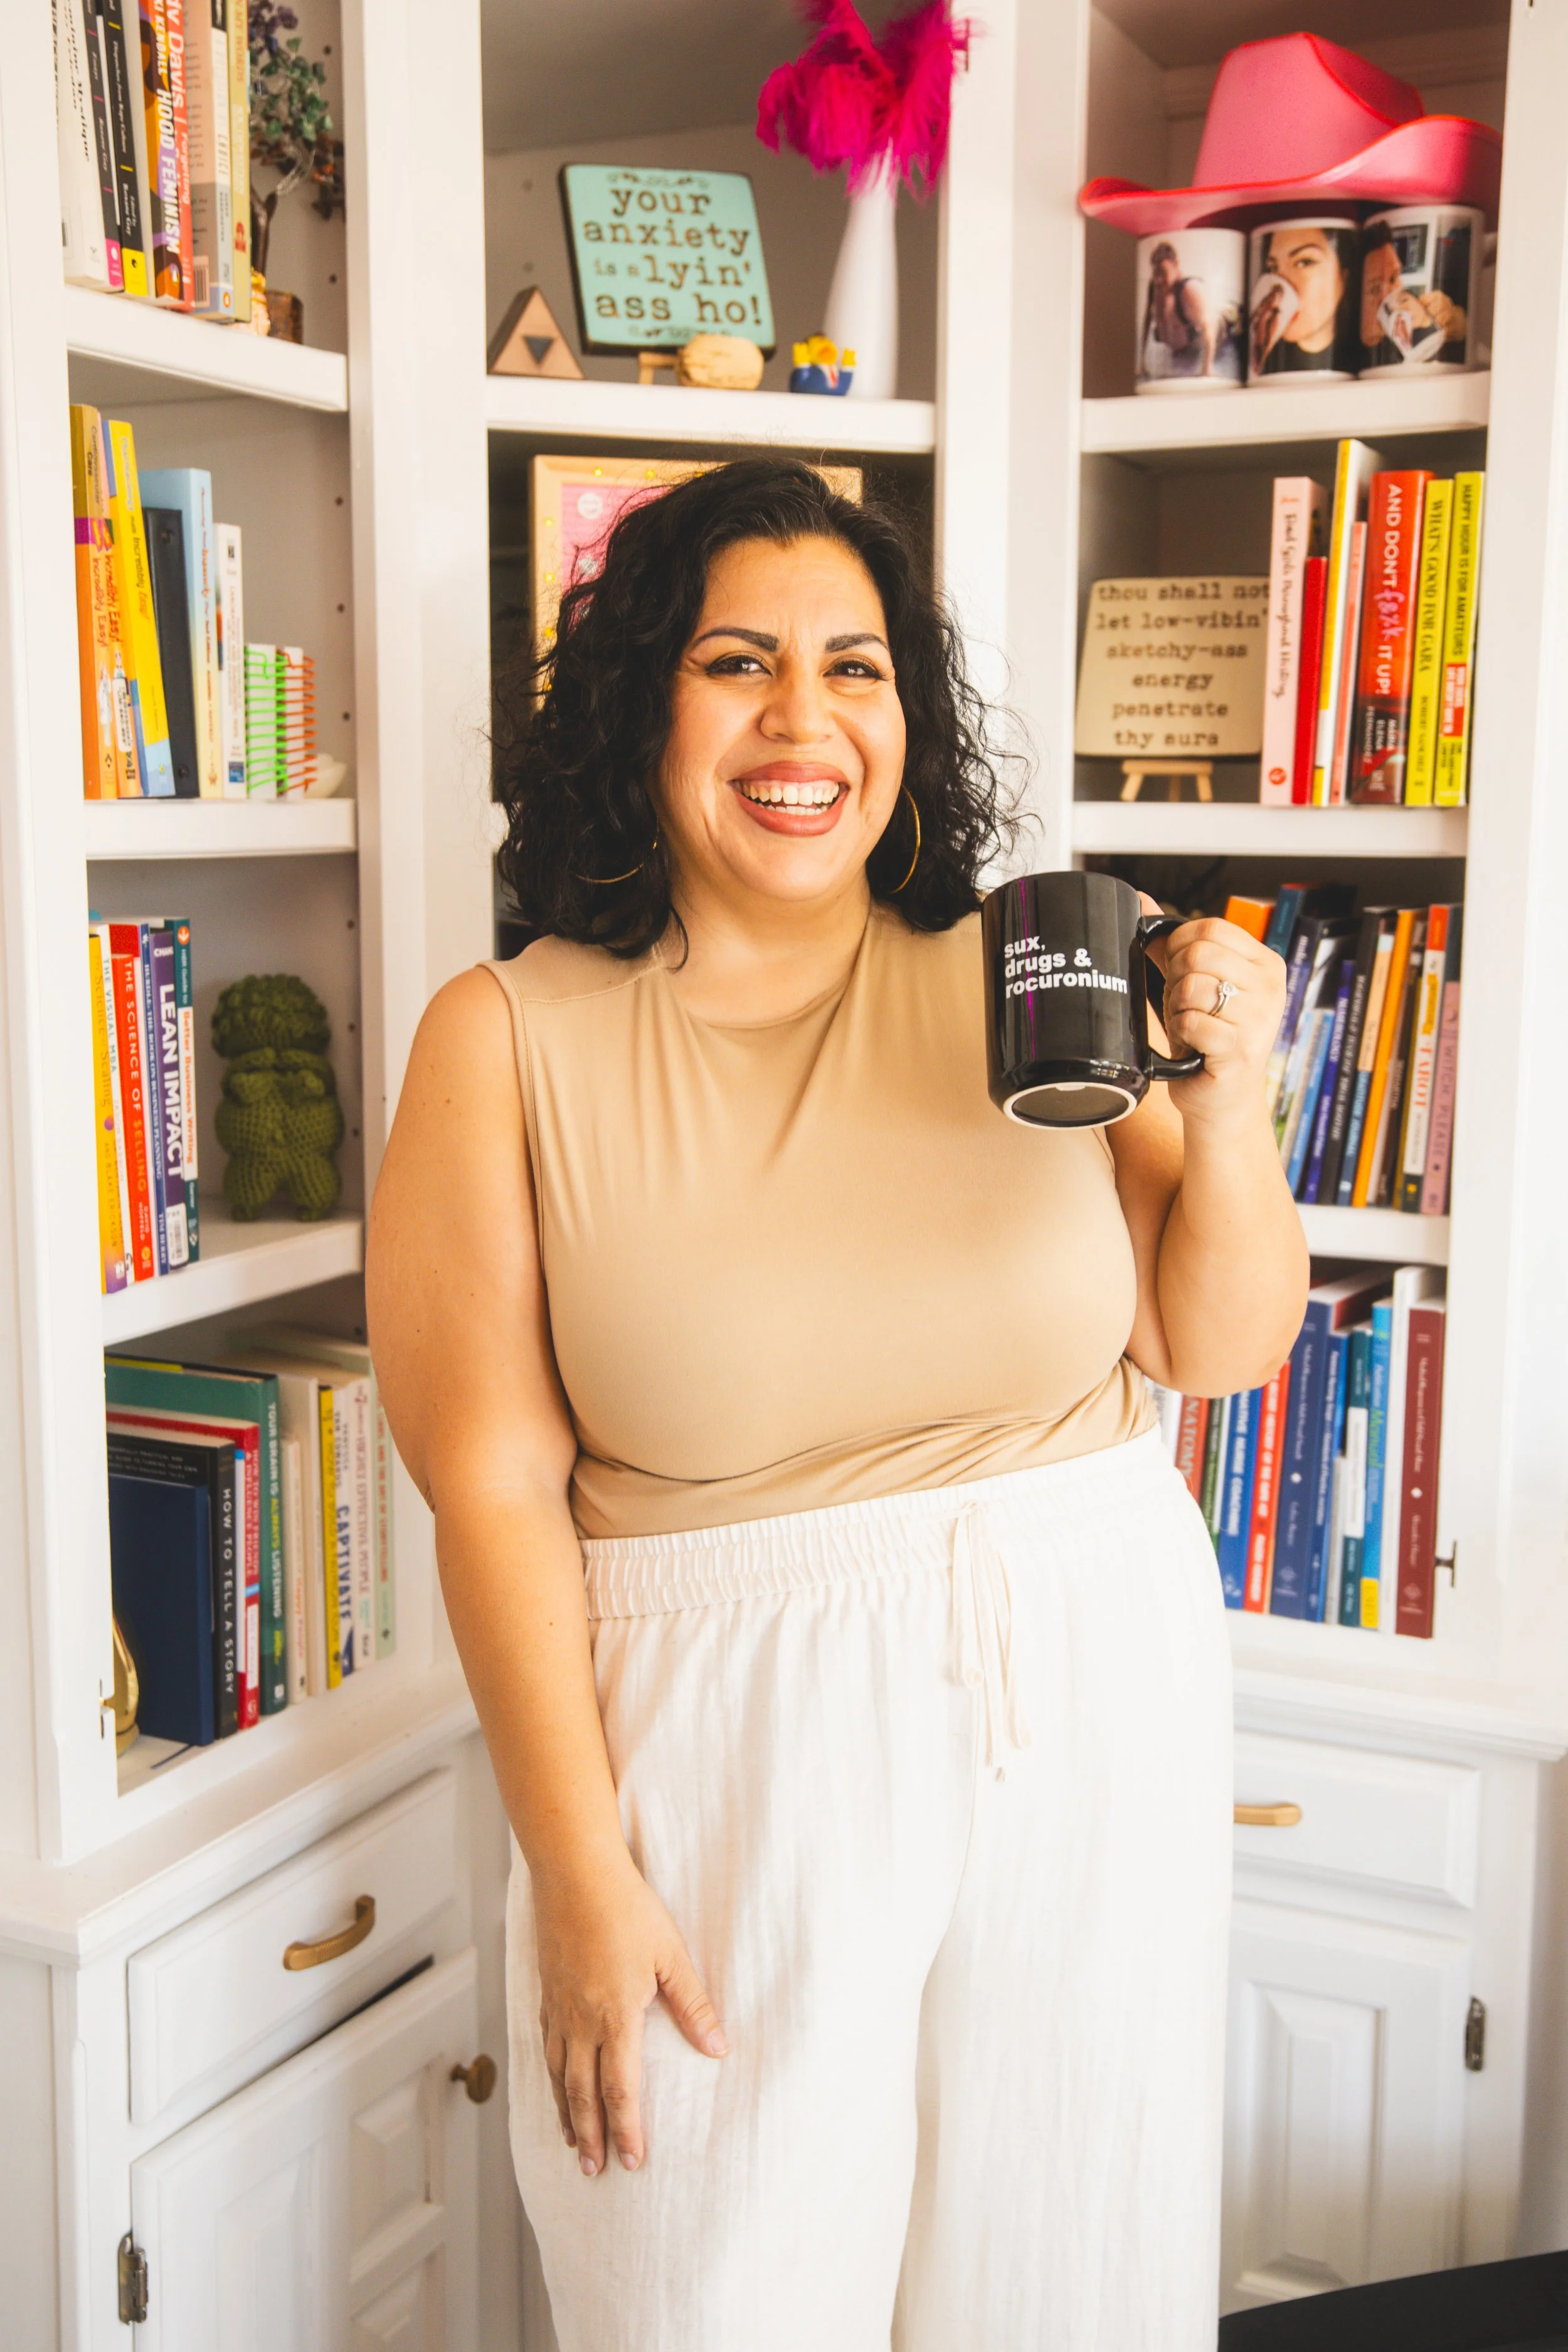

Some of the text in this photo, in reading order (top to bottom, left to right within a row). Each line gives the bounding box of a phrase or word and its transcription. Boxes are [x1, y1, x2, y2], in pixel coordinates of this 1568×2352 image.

[154, 16, 167, 76] KENDALL
[167, 32, 185, 109] Davis
[156, 88, 181, 254] HOOD FEMINISM
[611, 189, 711, 216] your
[583, 217, 750, 257] anxiety
[594, 254, 751, 290] is a lyin'
[595, 292, 761, 326] ass ho!
[92, 425, 100, 505] Cardiovascular
[1385, 484, 1403, 527] AND
[1461, 484, 1473, 521] HAPPY
[1382, 529, 1401, 587] DON'T
[1459, 524, 1471, 554] HOUR
[105, 554, 119, 608] Incredibly
[132, 537, 145, 588] Incredibly
[93, 558, 106, 612] Incredibly
[1098, 585, 1148, 601] thou
[1157, 581, 1222, 601] shall
[1096, 612, 1131, 630] let
[1106, 642, 1248, 662] sketchy-ass
[1377, 645, 1392, 660] IT
[1132, 674, 1214, 692] energy
[1375, 664, 1392, 695] UP!
[1111, 701, 1229, 721] penetrate
[1115, 730, 1219, 750] thy aura
[1004, 934, 1046, 958] sux,
[1005, 948, 1093, 978] drugs &
[182, 993, 188, 1004] to
[1005, 970, 1128, 999] rocuronium
[103, 958, 118, 1074] THE VISUAL MBA
[147, 1010, 155, 1031] THE
[94, 975, 105, 1035] Science
[100, 1051, 114, 1108] Scaling
[148, 1033, 157, 1062] BOOK
[124, 962, 147, 1192] THE SCIENCE OF SELLING
[159, 983, 184, 1180] LEAN IMPACT
[184, 1055, 193, 1114] Business
[151, 1079, 159, 1128] BUSINESS
[1433, 1045, 1457, 1158] WITCH PLEASE
[154, 1129, 162, 1180] PLANNING
[186, 1116, 195, 1164] Writing
[106, 1162, 114, 1193] BLAKE
[108, 1198, 118, 1247] ERICKSON
[268, 1402, 278, 1437] YOUR
[268, 1439, 278, 1480] BRAIN
[270, 1481, 278, 1496] IS
[270, 1497, 280, 1549] ALWAYS
[336, 1505, 352, 1620] CAPTIVATE
[222, 1488, 235, 1694] HOW TO TELL A STORY
[271, 1549, 283, 1618] LISTENING
